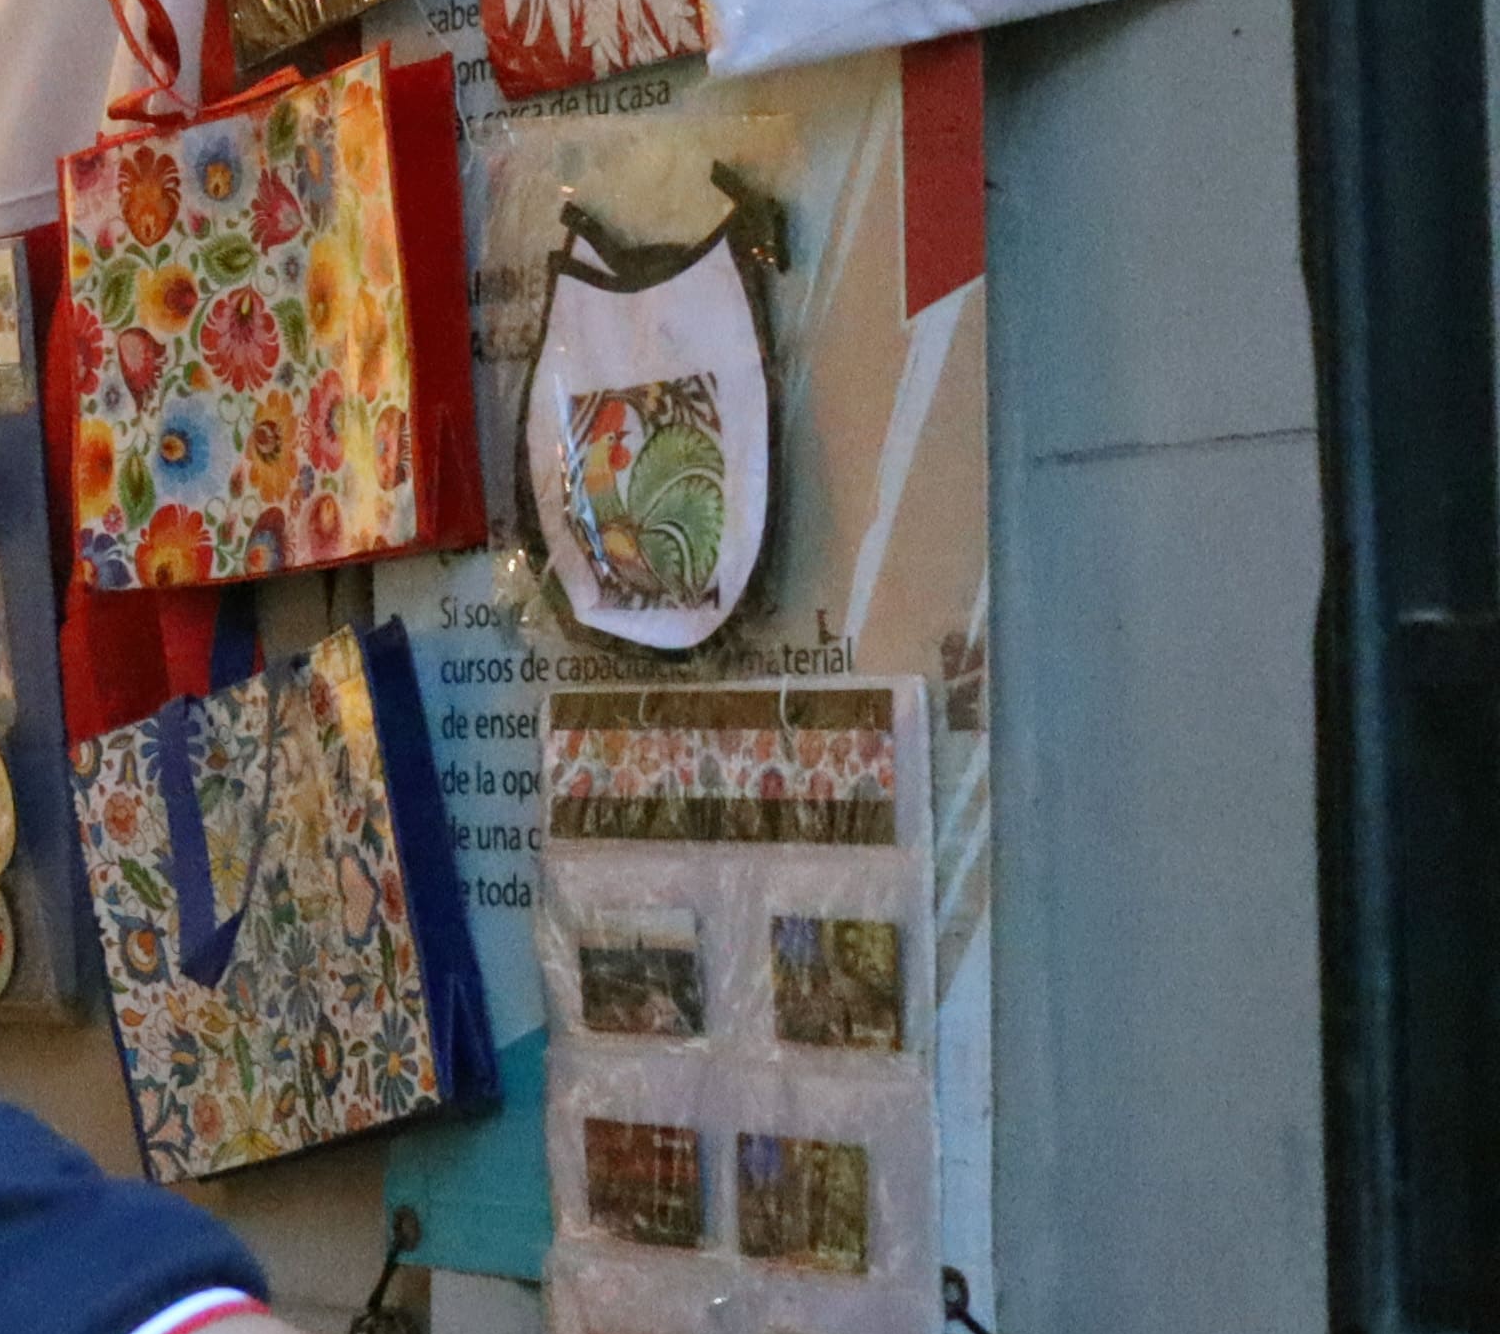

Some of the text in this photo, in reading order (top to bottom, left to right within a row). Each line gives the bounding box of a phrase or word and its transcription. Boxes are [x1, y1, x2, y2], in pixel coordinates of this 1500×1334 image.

[586, 84, 609, 116] tu
[616, 79, 670, 112] casa
[440, 595, 458, 630] Si
[464, 603, 502, 629] sos
[440, 658, 514, 684] cursos
[520, 646, 549, 683] de
[442, 705, 468, 739] de
[443, 760, 469, 796] de
[476, 760, 496, 796] la
[477, 825, 521, 851] una
[477, 872, 531, 907] toda
